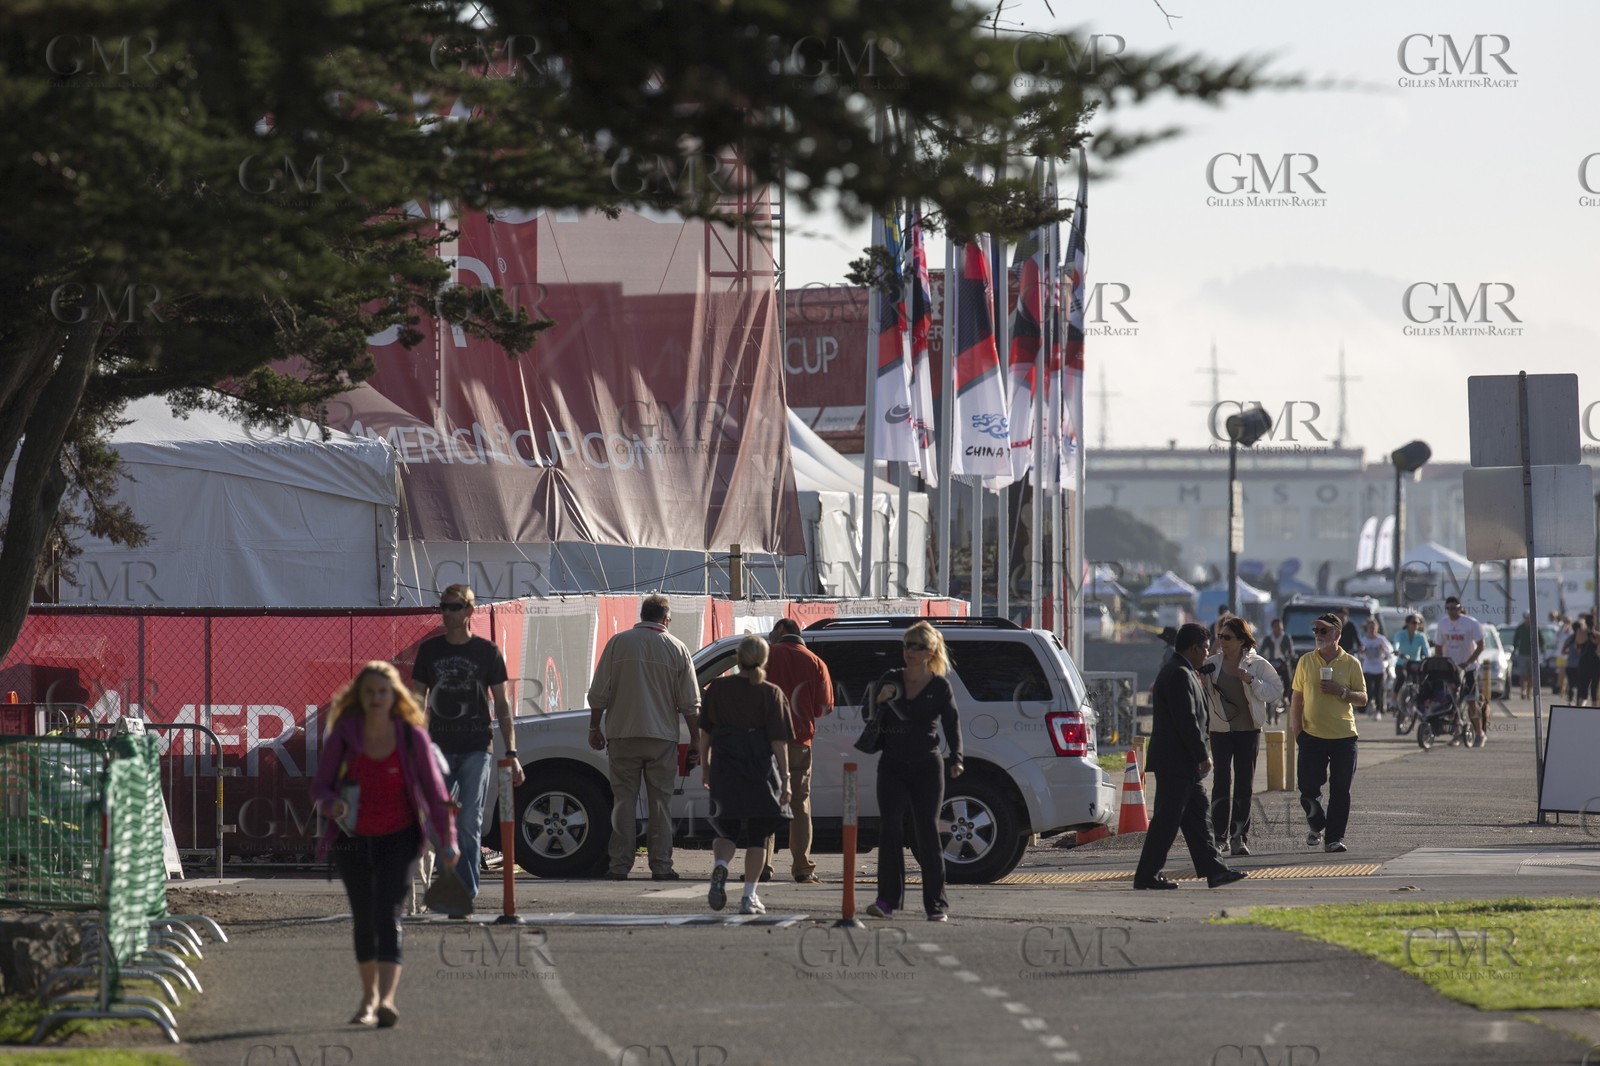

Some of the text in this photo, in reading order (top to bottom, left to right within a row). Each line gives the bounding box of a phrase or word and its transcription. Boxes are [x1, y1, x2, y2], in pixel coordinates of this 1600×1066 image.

[786, 336, 839, 375] CUP
[966, 445, 1004, 456] CHINA
[1178, 482, 1388, 505] MSON
[75, 689, 327, 777] AMERI
